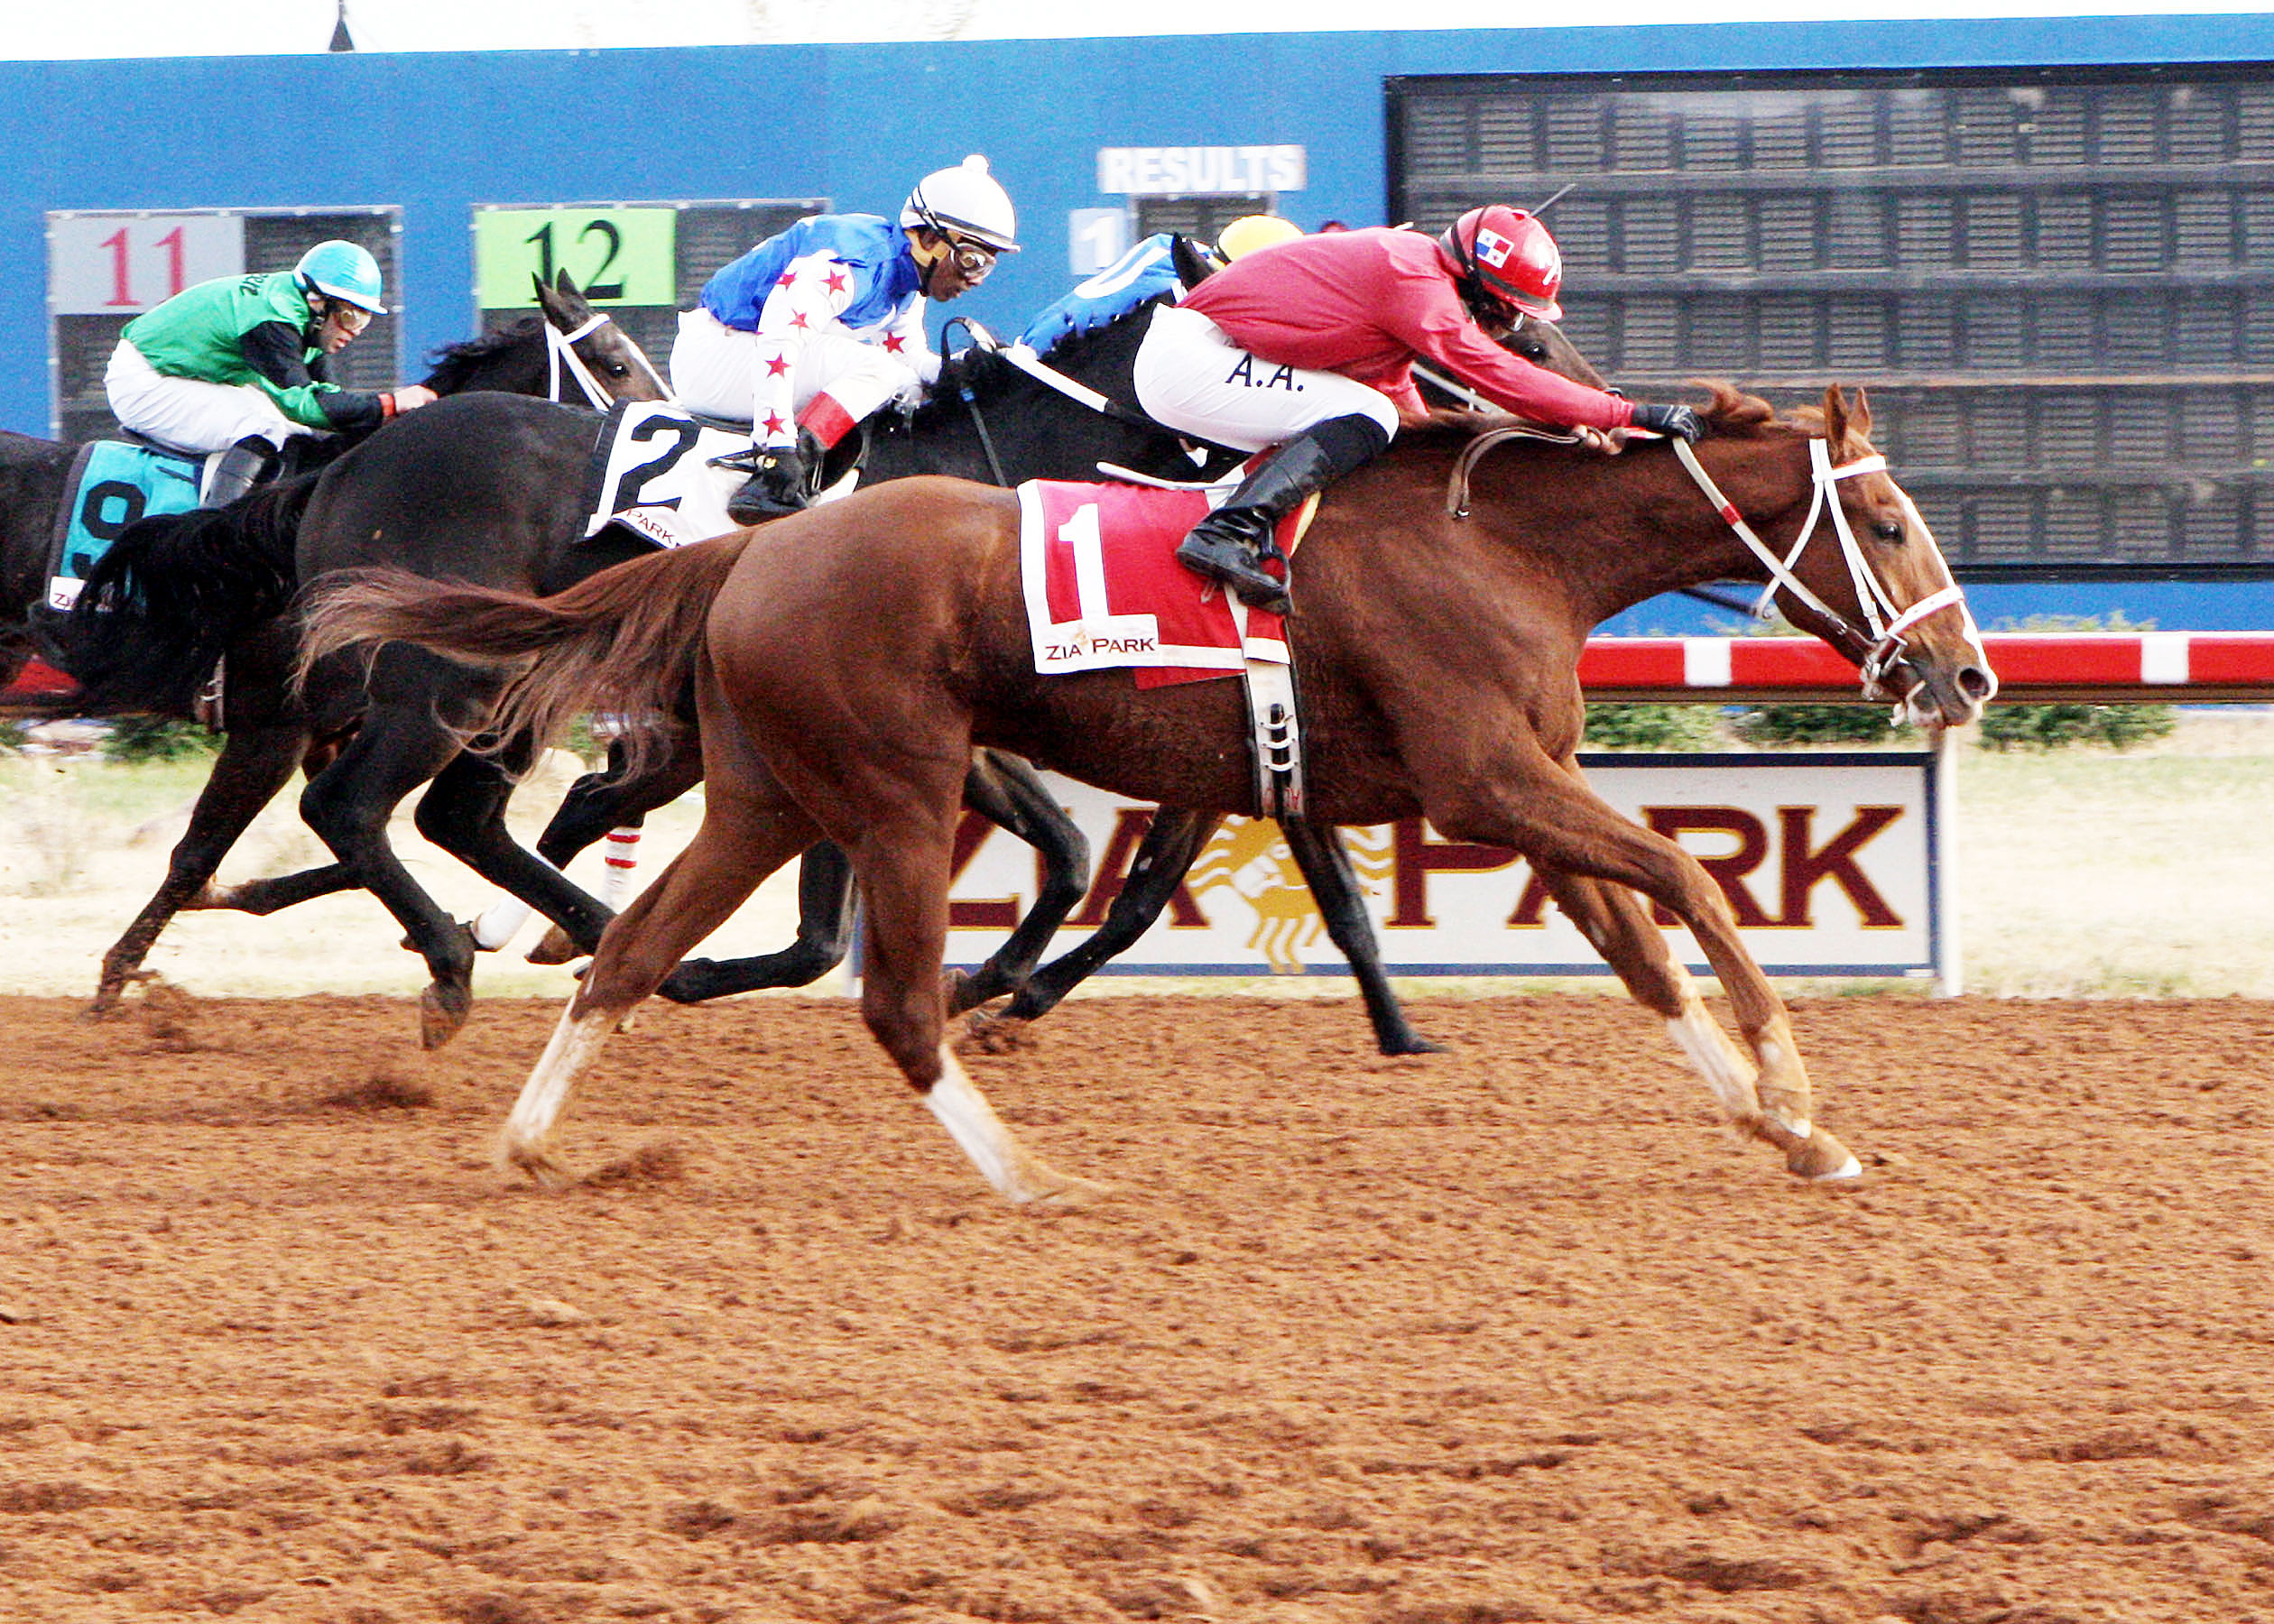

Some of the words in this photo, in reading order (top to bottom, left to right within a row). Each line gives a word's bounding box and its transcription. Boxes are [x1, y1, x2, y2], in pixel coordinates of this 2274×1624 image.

[1102, 146, 1303, 192] RESULTS
[99, 226, 186, 307] 11
[526, 219, 624, 301] 12
[1080, 216, 1116, 269] 1
[1225, 351, 1304, 392] A.A.
[610, 414, 702, 517] 2
[71, 480, 147, 577] 9
[626, 508, 676, 544] PARK
[1058, 503, 1111, 621] 1
[1045, 643, 1082, 660] ZIA
[1091, 637, 1156, 654] PARK
[1383, 805, 1906, 930] PRK
